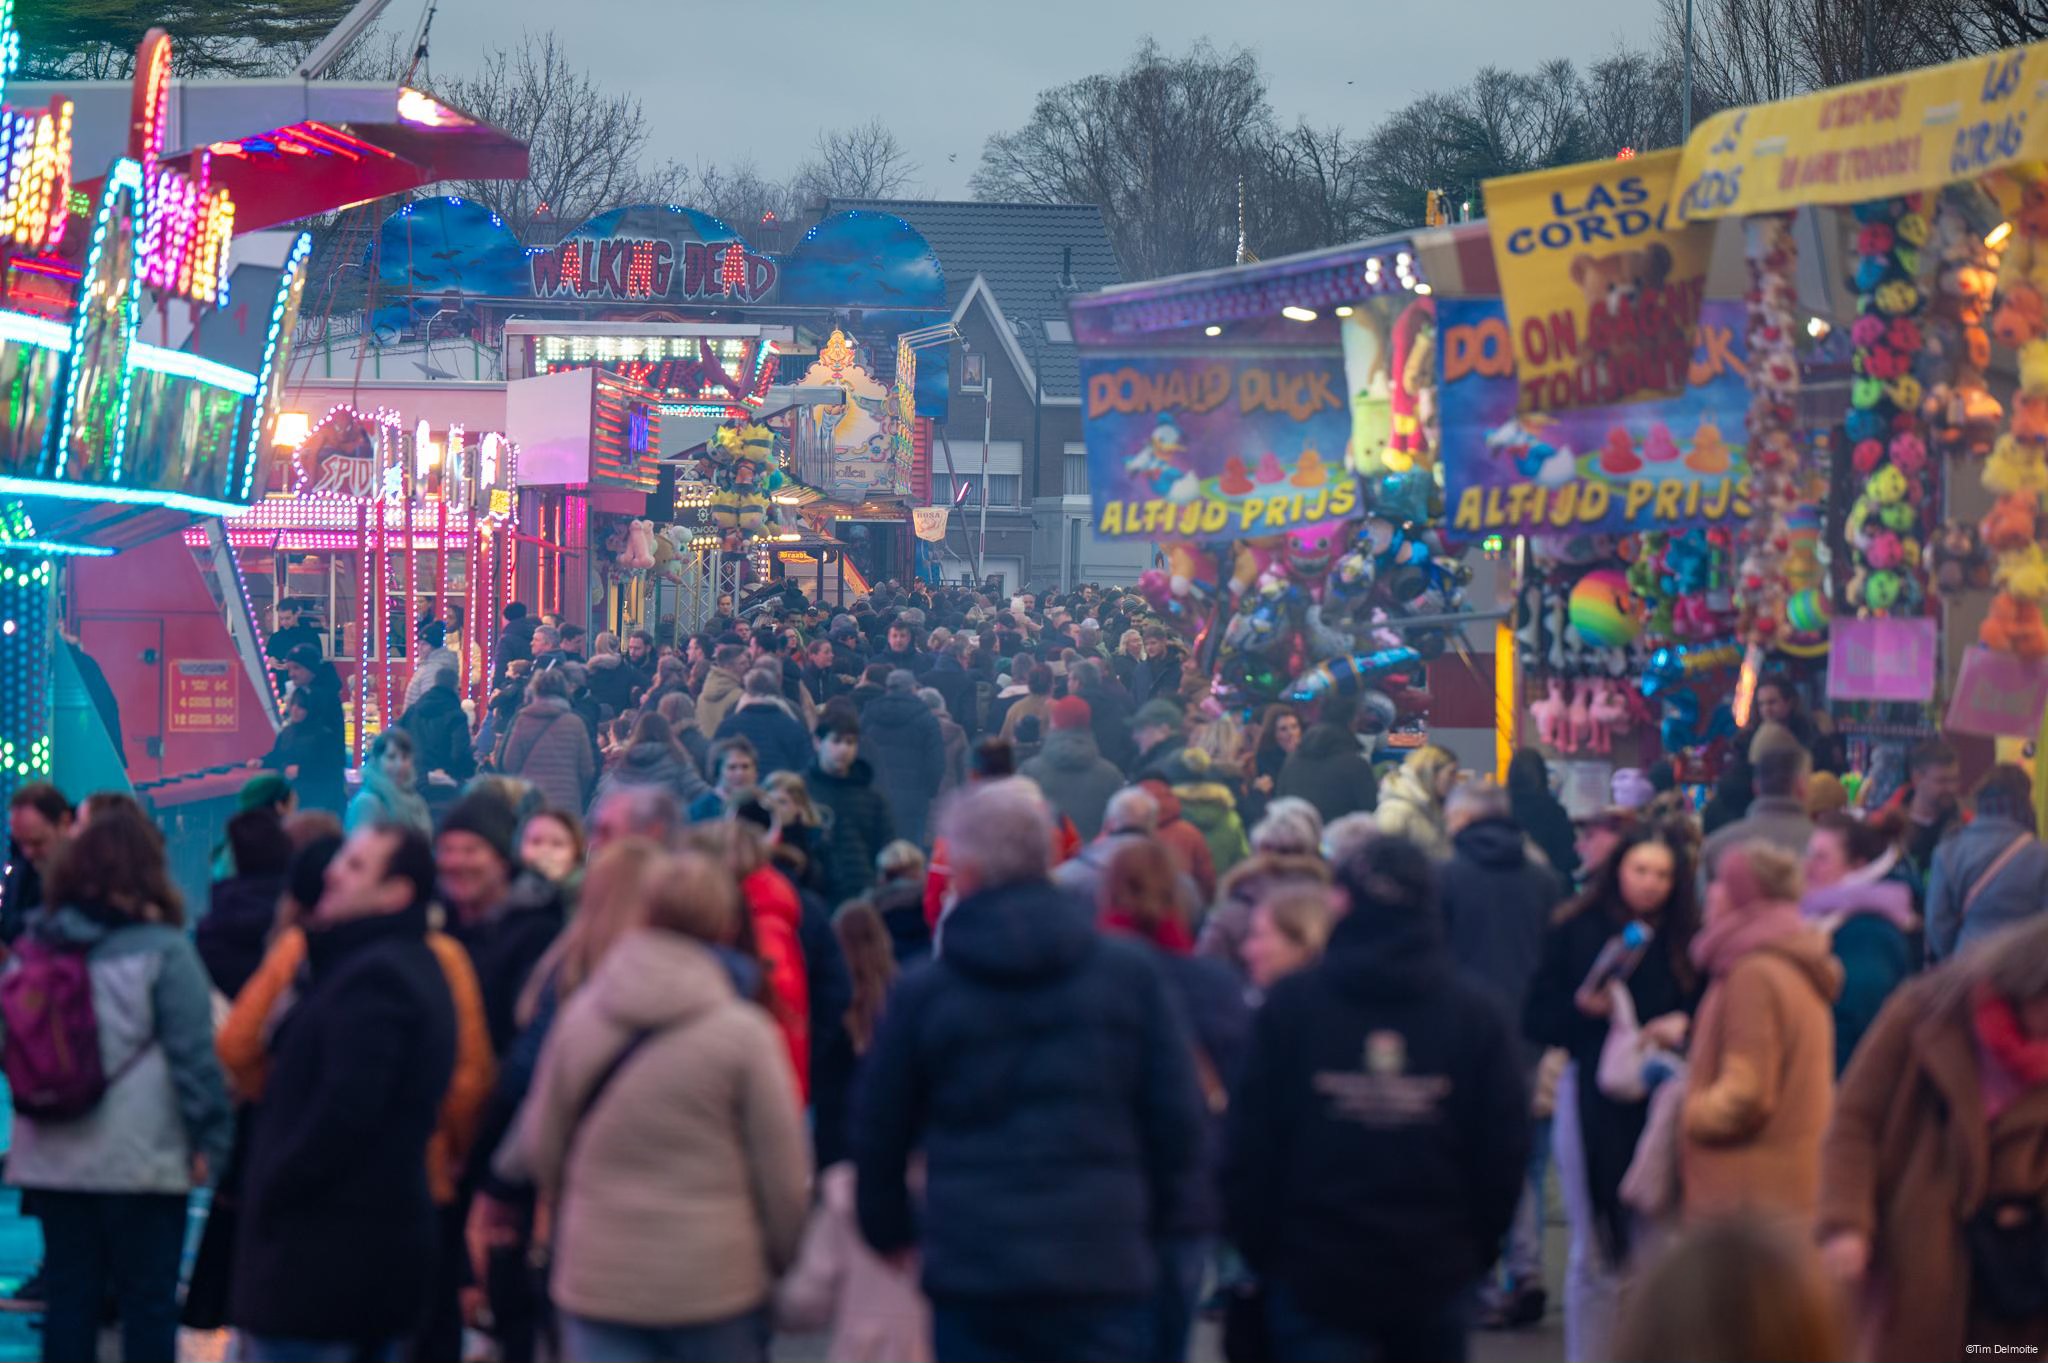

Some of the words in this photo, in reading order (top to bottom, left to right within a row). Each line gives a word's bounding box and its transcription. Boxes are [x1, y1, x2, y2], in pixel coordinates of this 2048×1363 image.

[1552, 176, 1648, 216] LAS
[1508, 203, 1668, 255] CORD
[532, 238, 673, 299] WALKING
[683, 241, 776, 302] DEAD
[1522, 308, 1578, 368] ON
[1088, 365, 1231, 419] DONALD
[1240, 367, 1342, 422] DUCK
[1100, 499, 1228, 535] ALTIJD
[1240, 480, 1356, 530] PRIJS
[1454, 483, 1611, 531] ALTIJD
